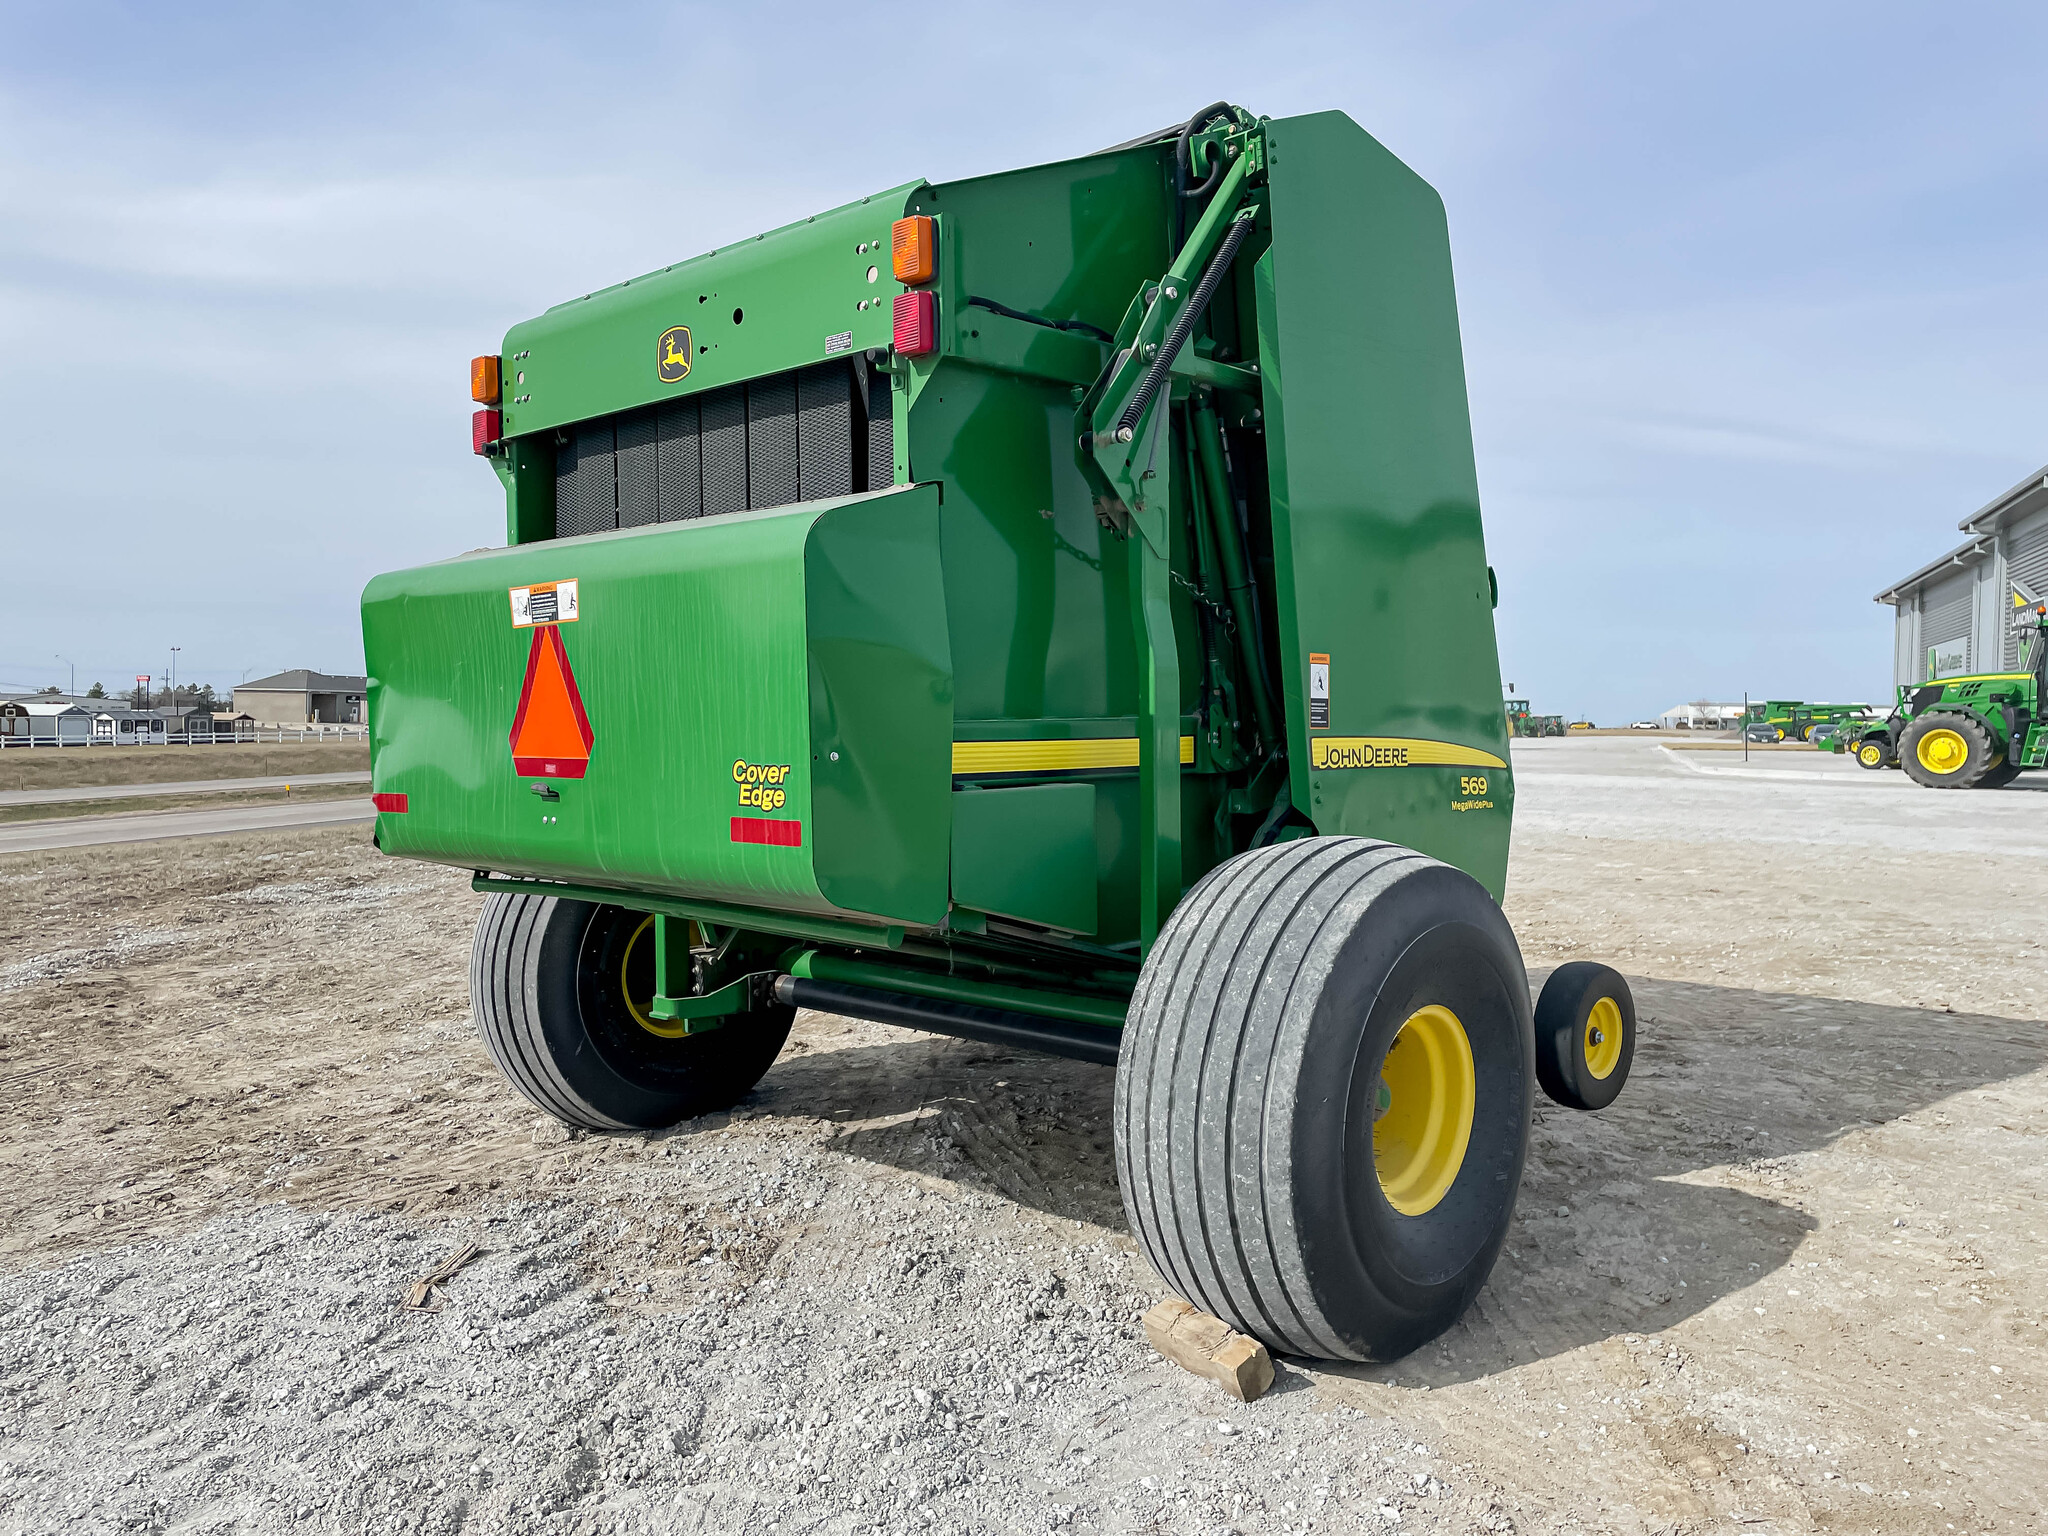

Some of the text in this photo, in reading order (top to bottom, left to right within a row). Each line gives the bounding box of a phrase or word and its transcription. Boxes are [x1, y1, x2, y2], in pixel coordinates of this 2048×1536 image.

[1320, 744, 1408, 766] JOHN DEERE
[732, 759, 790, 784] Cover
[739, 783, 786, 812] Edge
[1460, 776, 1488, 796] 569
